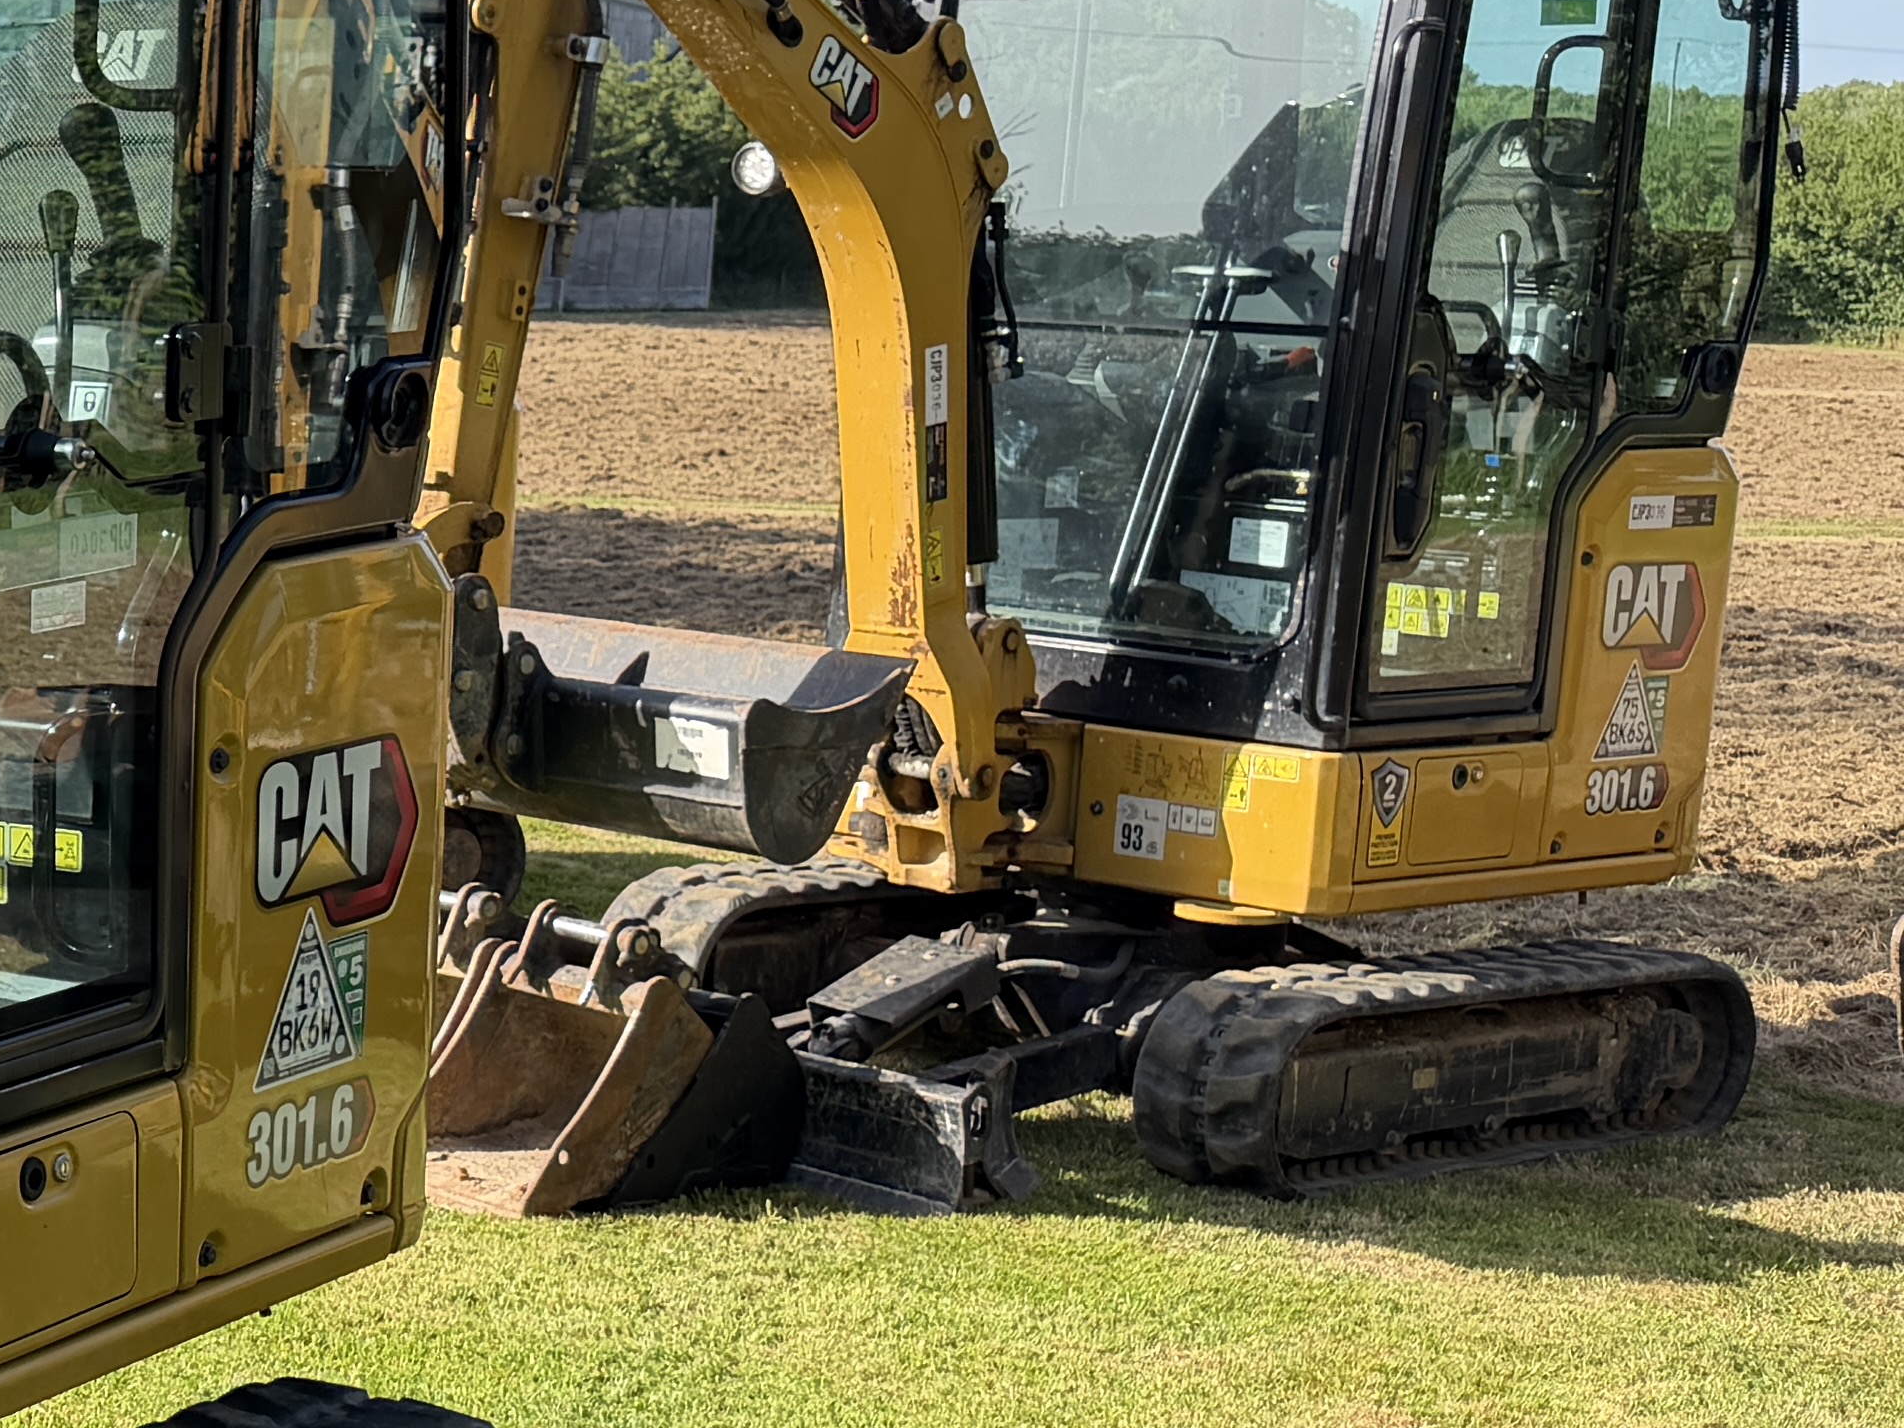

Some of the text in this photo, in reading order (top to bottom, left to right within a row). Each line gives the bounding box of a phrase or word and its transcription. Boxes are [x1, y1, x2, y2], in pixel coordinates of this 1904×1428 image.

[810, 35, 874, 117] CAT
[1603, 564, 1686, 648] CAT
[1383, 773, 1397, 801] 2
[1585, 765, 1657, 814] 301.6
[258, 740, 382, 902] CAT
[1120, 822, 1144, 851] 93
[295, 970, 321, 1012] 19
[349, 954, 364, 986] 5
[278, 1006, 334, 1059] BK6W
[247, 1084, 354, 1184] 301.6
